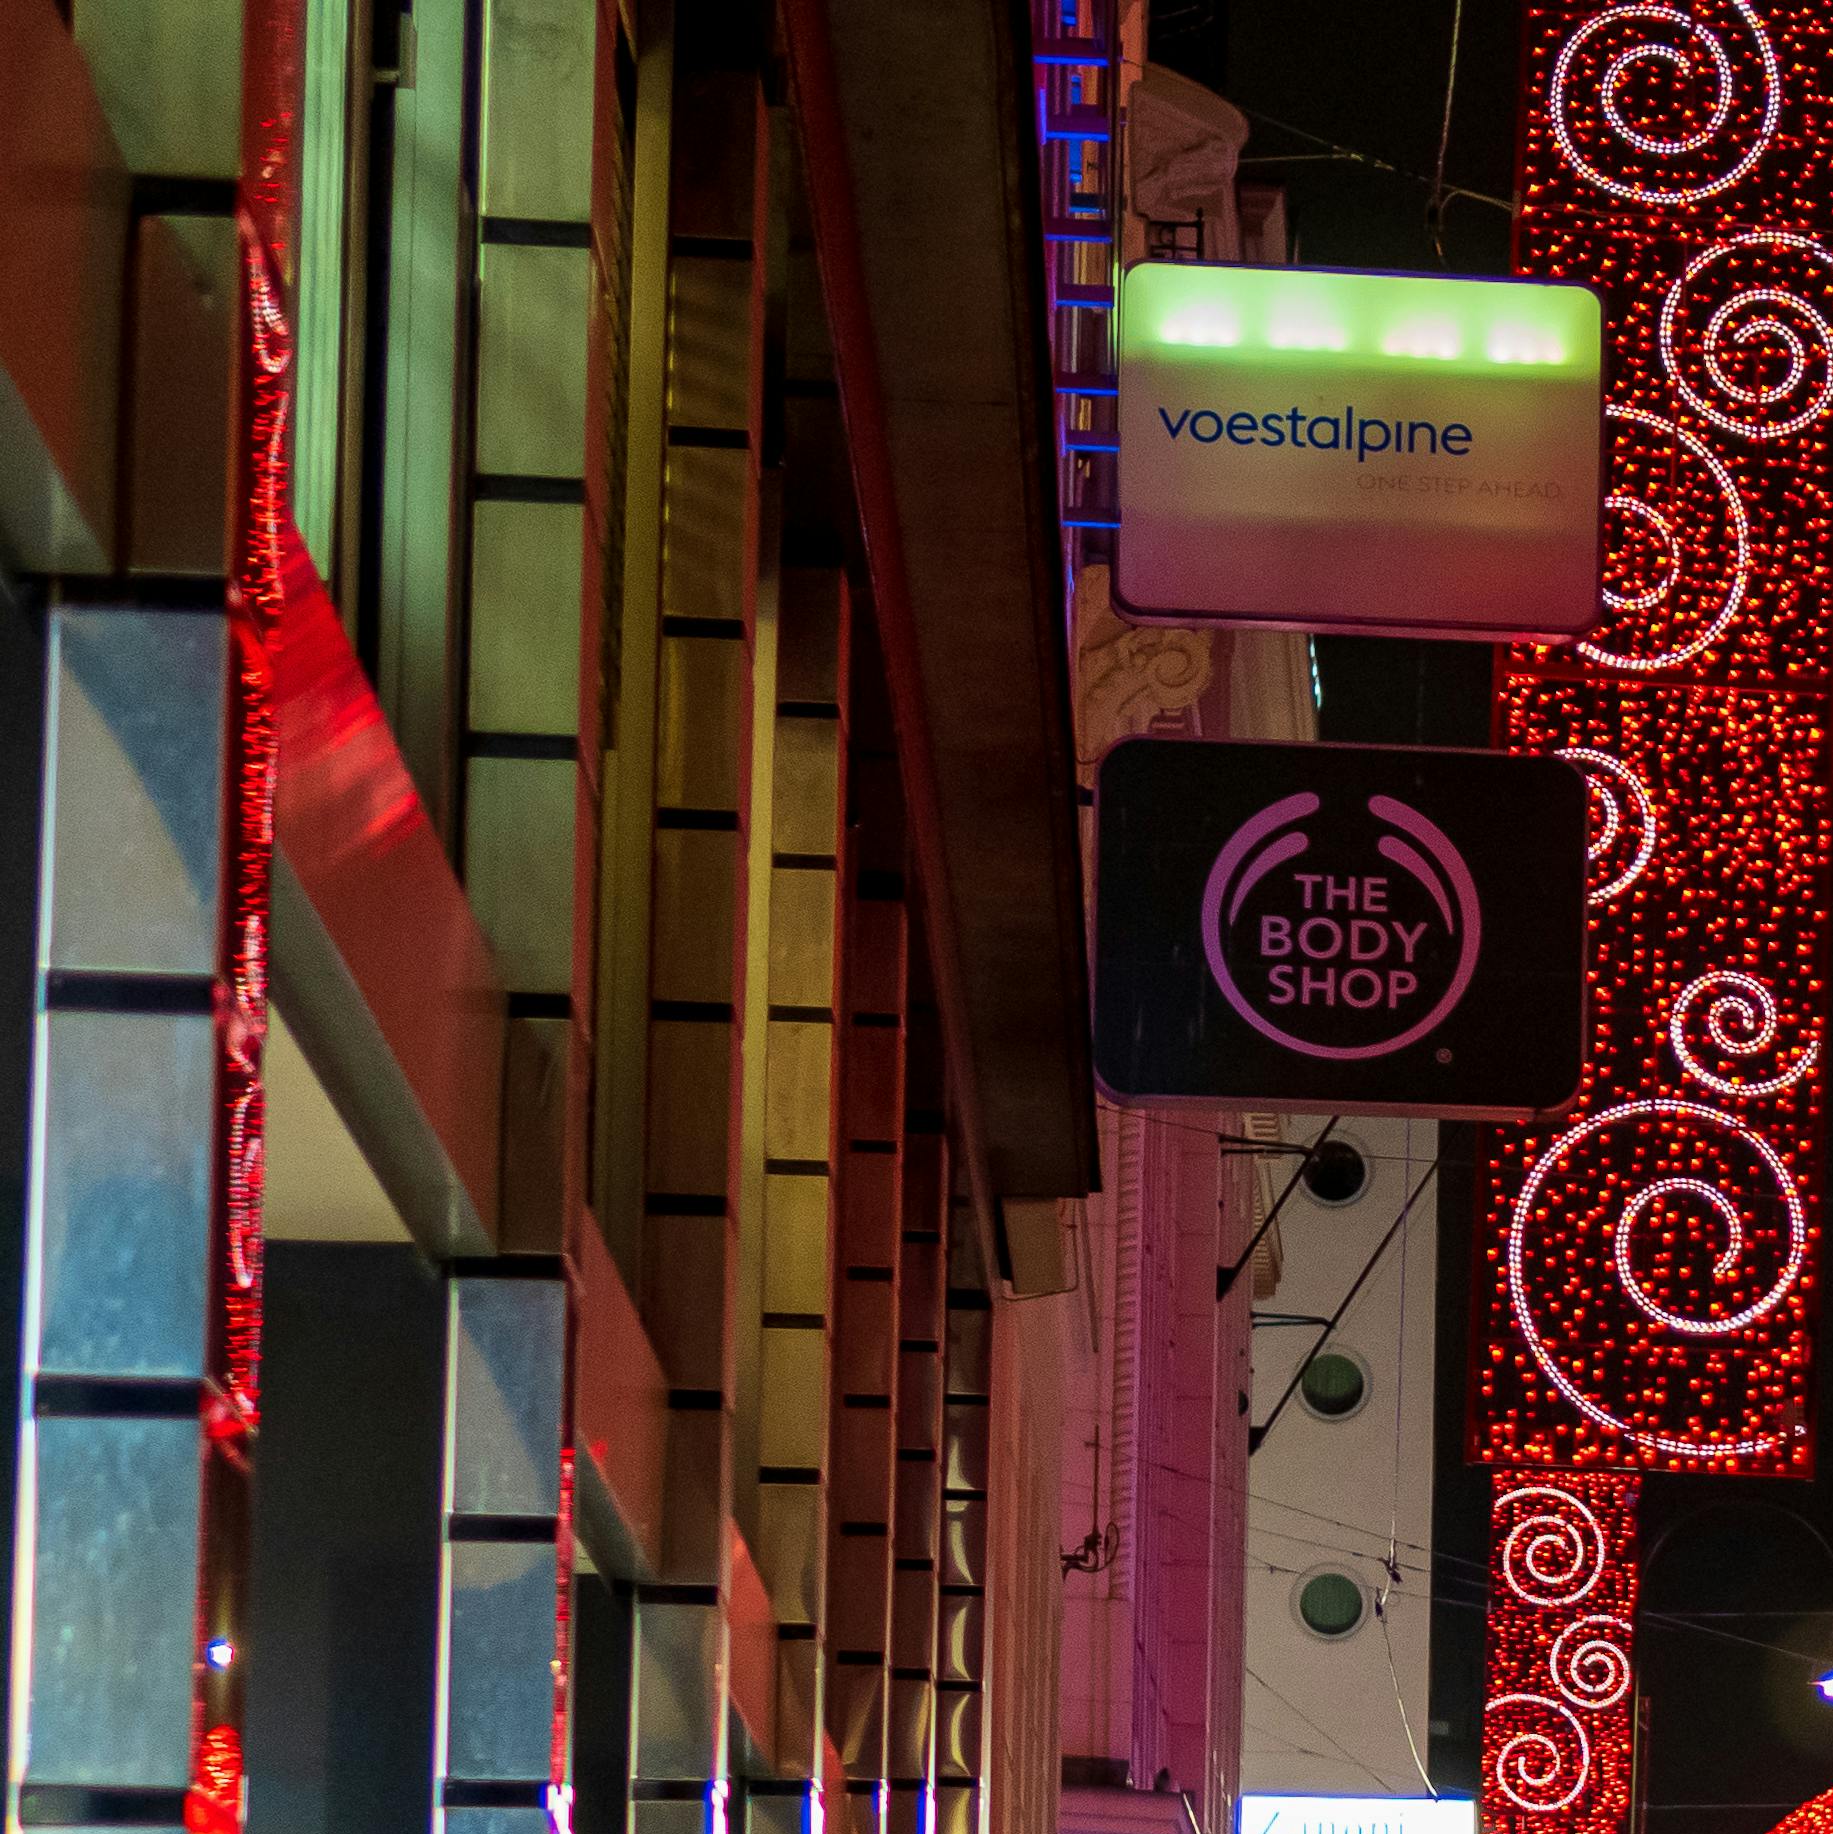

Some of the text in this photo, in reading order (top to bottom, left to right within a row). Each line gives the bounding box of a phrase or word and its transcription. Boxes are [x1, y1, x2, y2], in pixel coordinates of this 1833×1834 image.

[1158, 405, 1473, 463] voestalpine
[1294, 873, 1388, 912] THE
[1260, 915, 1428, 963] BODY
[1268, 964, 1418, 1009] SHOP
